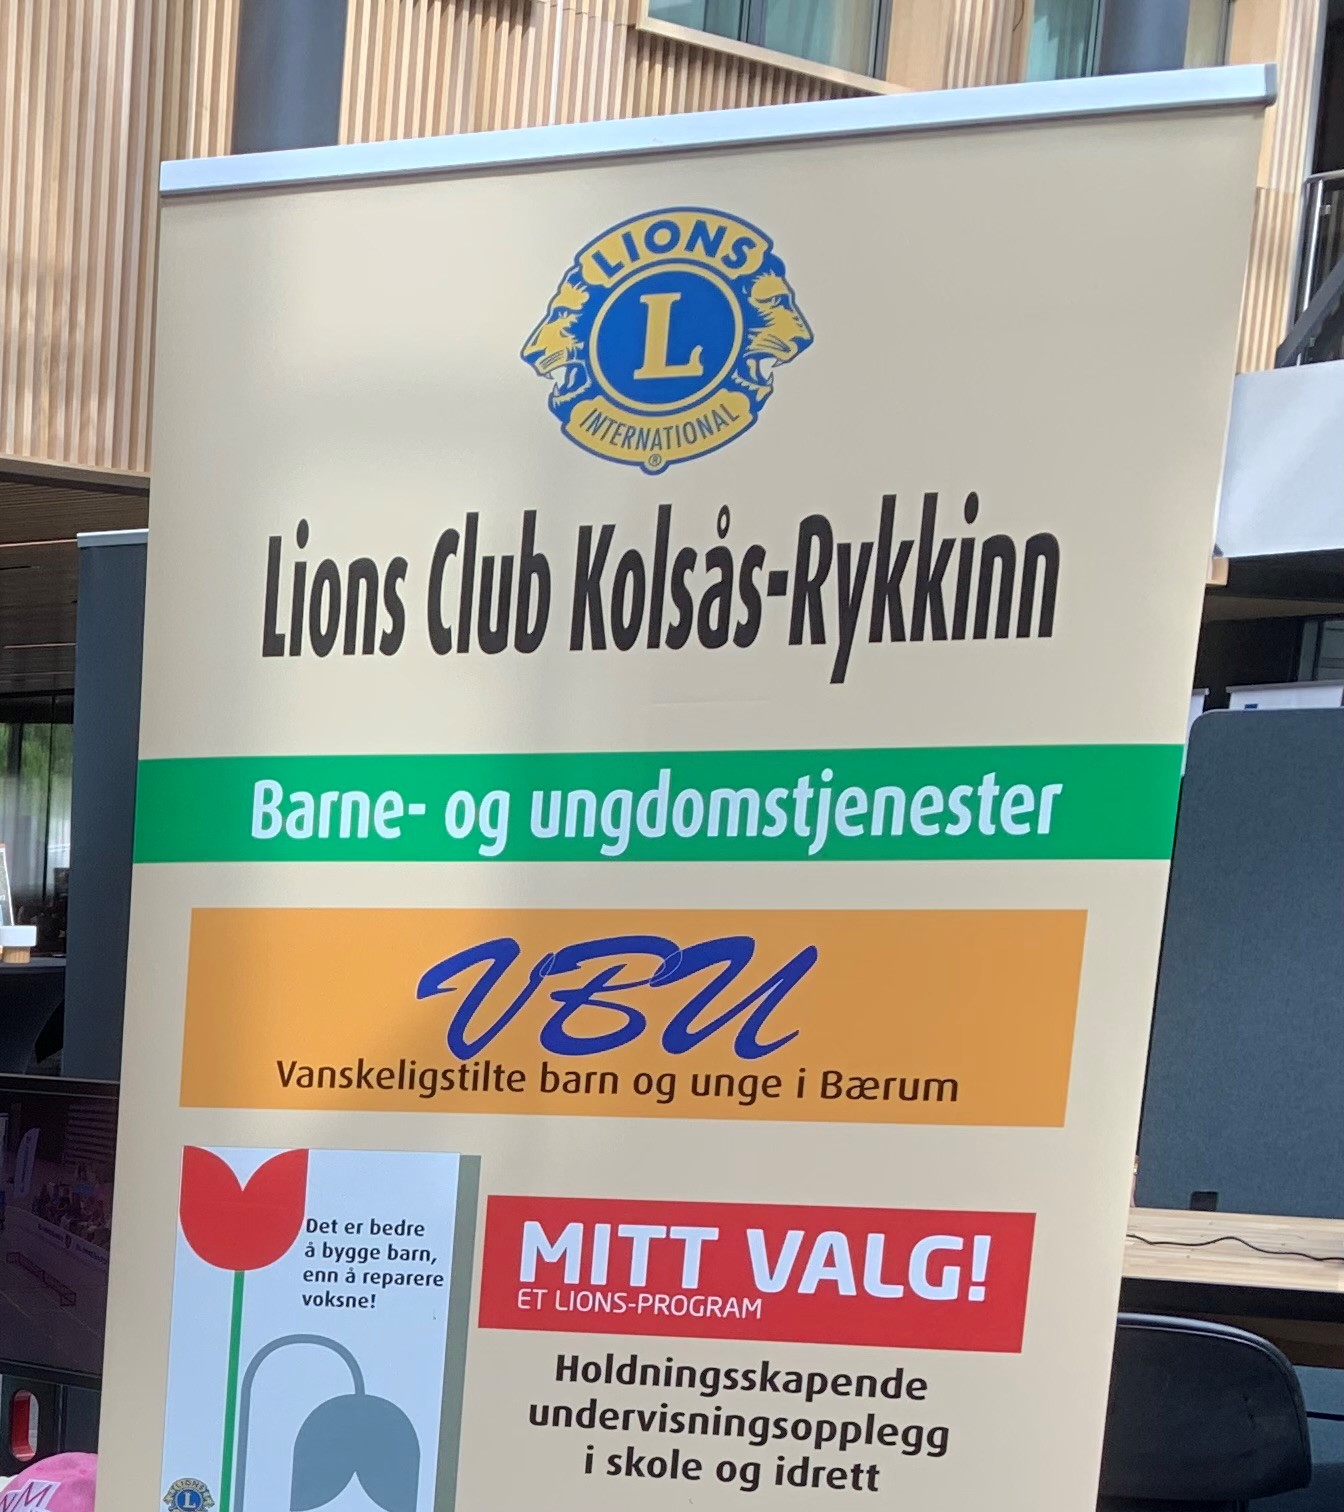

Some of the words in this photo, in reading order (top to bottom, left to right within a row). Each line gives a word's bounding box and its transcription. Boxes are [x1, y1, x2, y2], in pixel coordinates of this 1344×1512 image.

[592, 219, 757, 279] LIONS
[633, 292, 704, 380] L
[579, 403, 741, 451] INTERNATIONAL
[261, 518, 408, 658] Lions
[426, 509, 551, 655] Club
[569, 490, 1061, 685] Kolsås-Rykkinn
[251, 779, 425, 840] Barne-
[445, 788, 510, 857] og
[529, 767, 1063, 857] ungdomstjenester
[416, 935, 818, 1060] VBU
[277, 1060, 527, 1099] Vanskeligstilte
[540, 1062, 618, 1096] barn
[633, 1072, 676, 1104] og
[692, 1072, 782, 1106] unge
[797, 1067, 806, 1099] i
[820, 1070, 959, 1103] Bærum
[306, 1218, 338, 1234] Det
[345, 1222, 363, 1234] er
[370, 1218, 425, 1236] bedre
[305, 1242, 315, 1258] å
[322, 1241, 381, 1263] bygge
[387, 1244, 437, 1265] barn,
[519, 1220, 719, 1289] MITT
[746, 1229, 992, 1302] VALG!
[302, 1291, 376, 1308] voksne!
[303, 1269, 338, 1283] enn
[345, 1267, 355, 1284] å
[363, 1271, 444, 1288] reparere
[517, 1289, 548, 1310] ET
[555, 1290, 762, 1319] LIONS-PROGRAM
[555, 1353, 928, 1402] Holdningsskapende
[529, 1398, 950, 1458] undervisningsopplegg
[584, 1444, 594, 1475] i
[607, 1447, 703, 1482] skole
[715, 1460, 761, 1492] og
[775, 1456, 880, 1492] idrett
